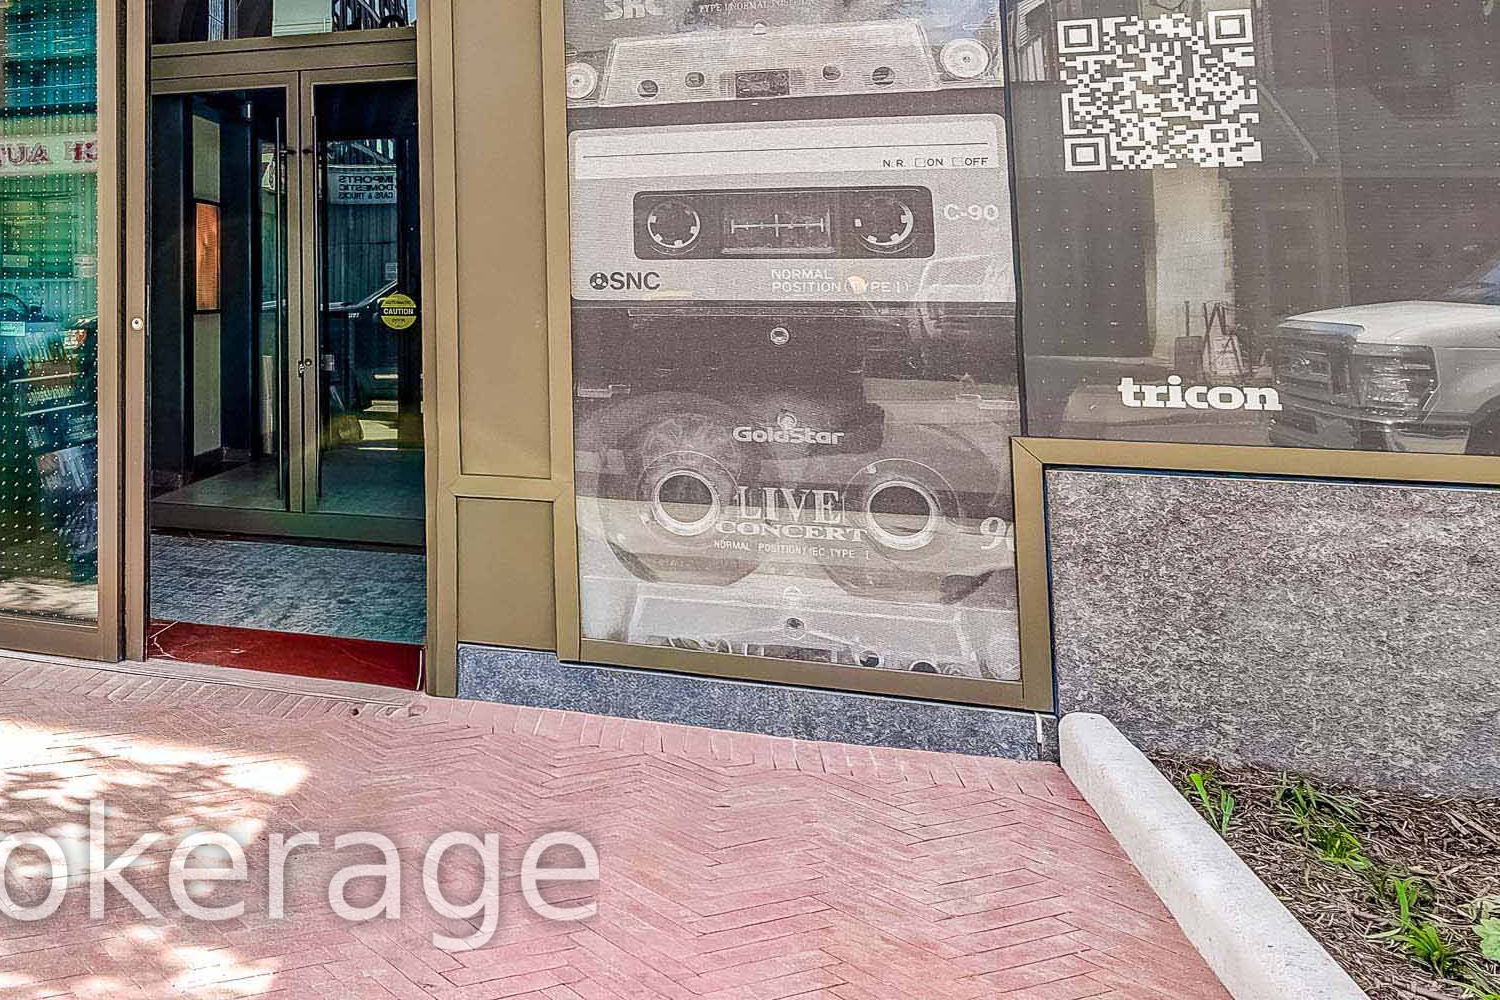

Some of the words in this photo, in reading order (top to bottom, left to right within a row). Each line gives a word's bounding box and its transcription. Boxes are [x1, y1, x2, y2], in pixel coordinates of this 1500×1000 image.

[926, 158, 944, 167] ON
[964, 157, 989, 166] OFF
[609, 271, 661, 291] SNC
[771, 268, 833, 281] NORMAL
[1117, 374, 1283, 411] tricon
[732, 425, 845, 445] GoldStar
[737, 485, 842, 524] LIVE
[715, 520, 868, 542] CONCERT
[714, 539, 750, 551] NORMAL
[830, 548, 856, 559] TYPE
